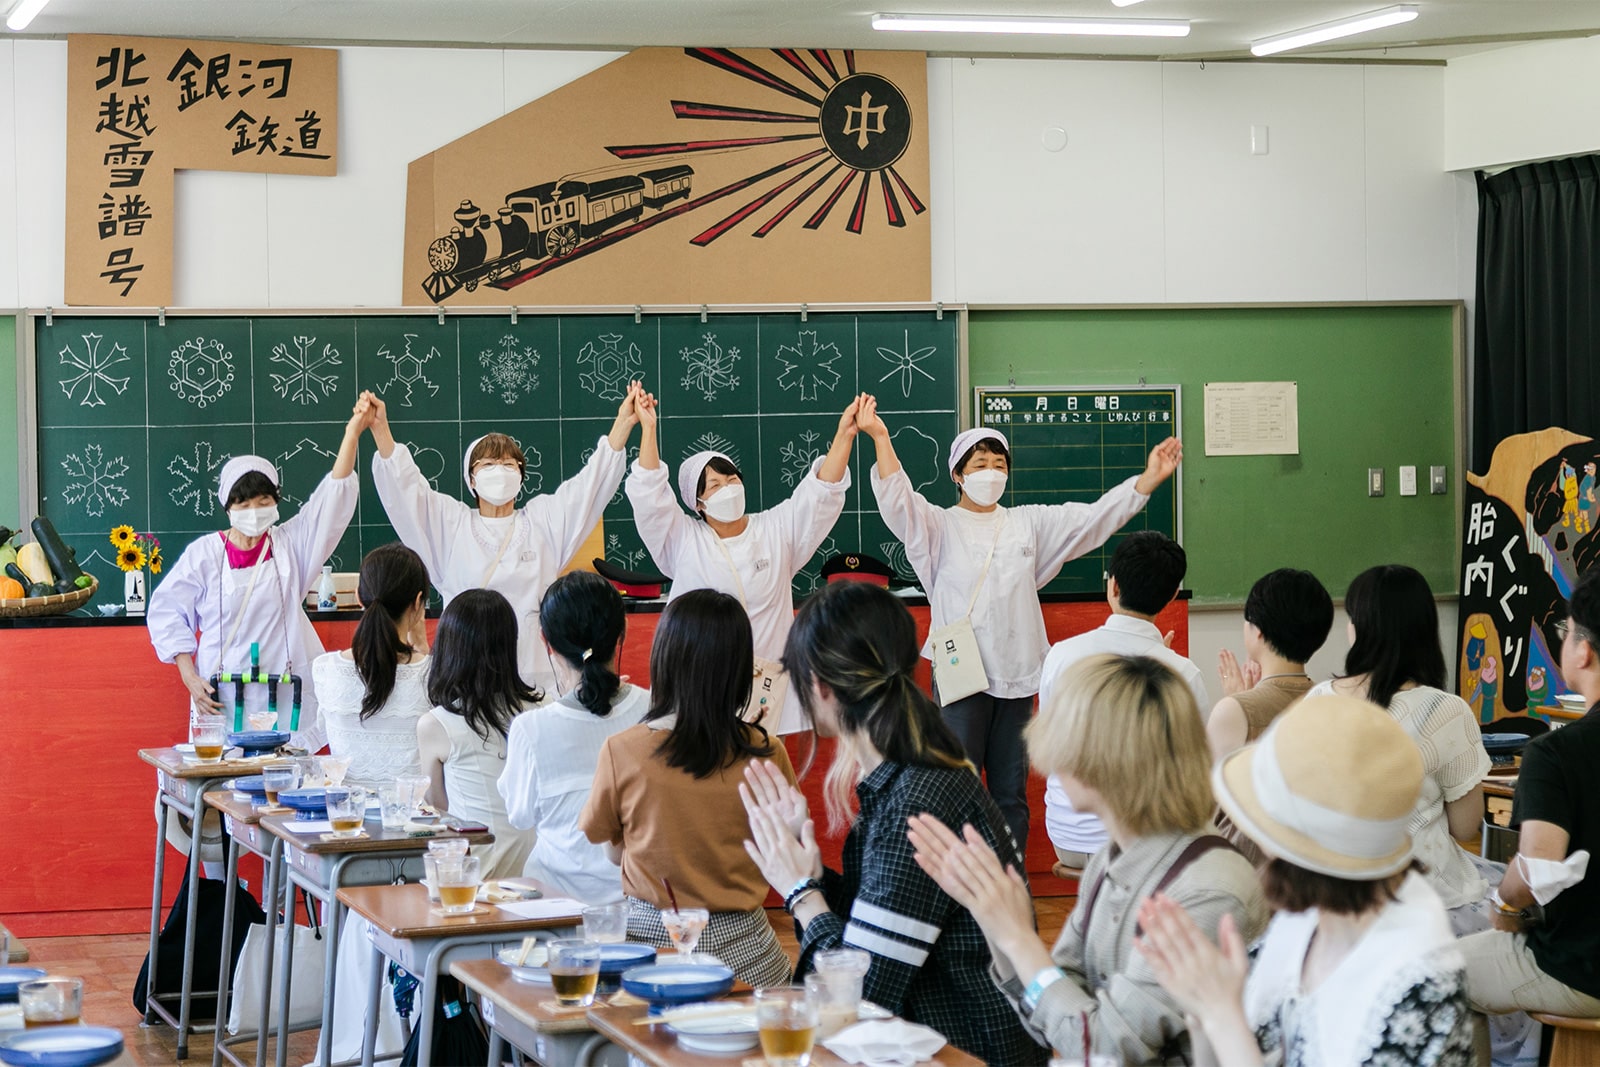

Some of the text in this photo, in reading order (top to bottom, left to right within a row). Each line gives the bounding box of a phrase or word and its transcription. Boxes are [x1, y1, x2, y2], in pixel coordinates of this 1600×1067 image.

[166, 47, 293, 112] 銀河
[225, 109, 332, 160] 鉄道
[842, 90, 889, 151] 中
[95, 47, 157, 297] 北越雪譜号
[1035, 396, 1119, 411] 月 日 曜日
[1108, 411, 1141, 423] じゅんび
[1464, 502, 1497, 597] 胎内
[1500, 535, 1528, 678] くぐり
